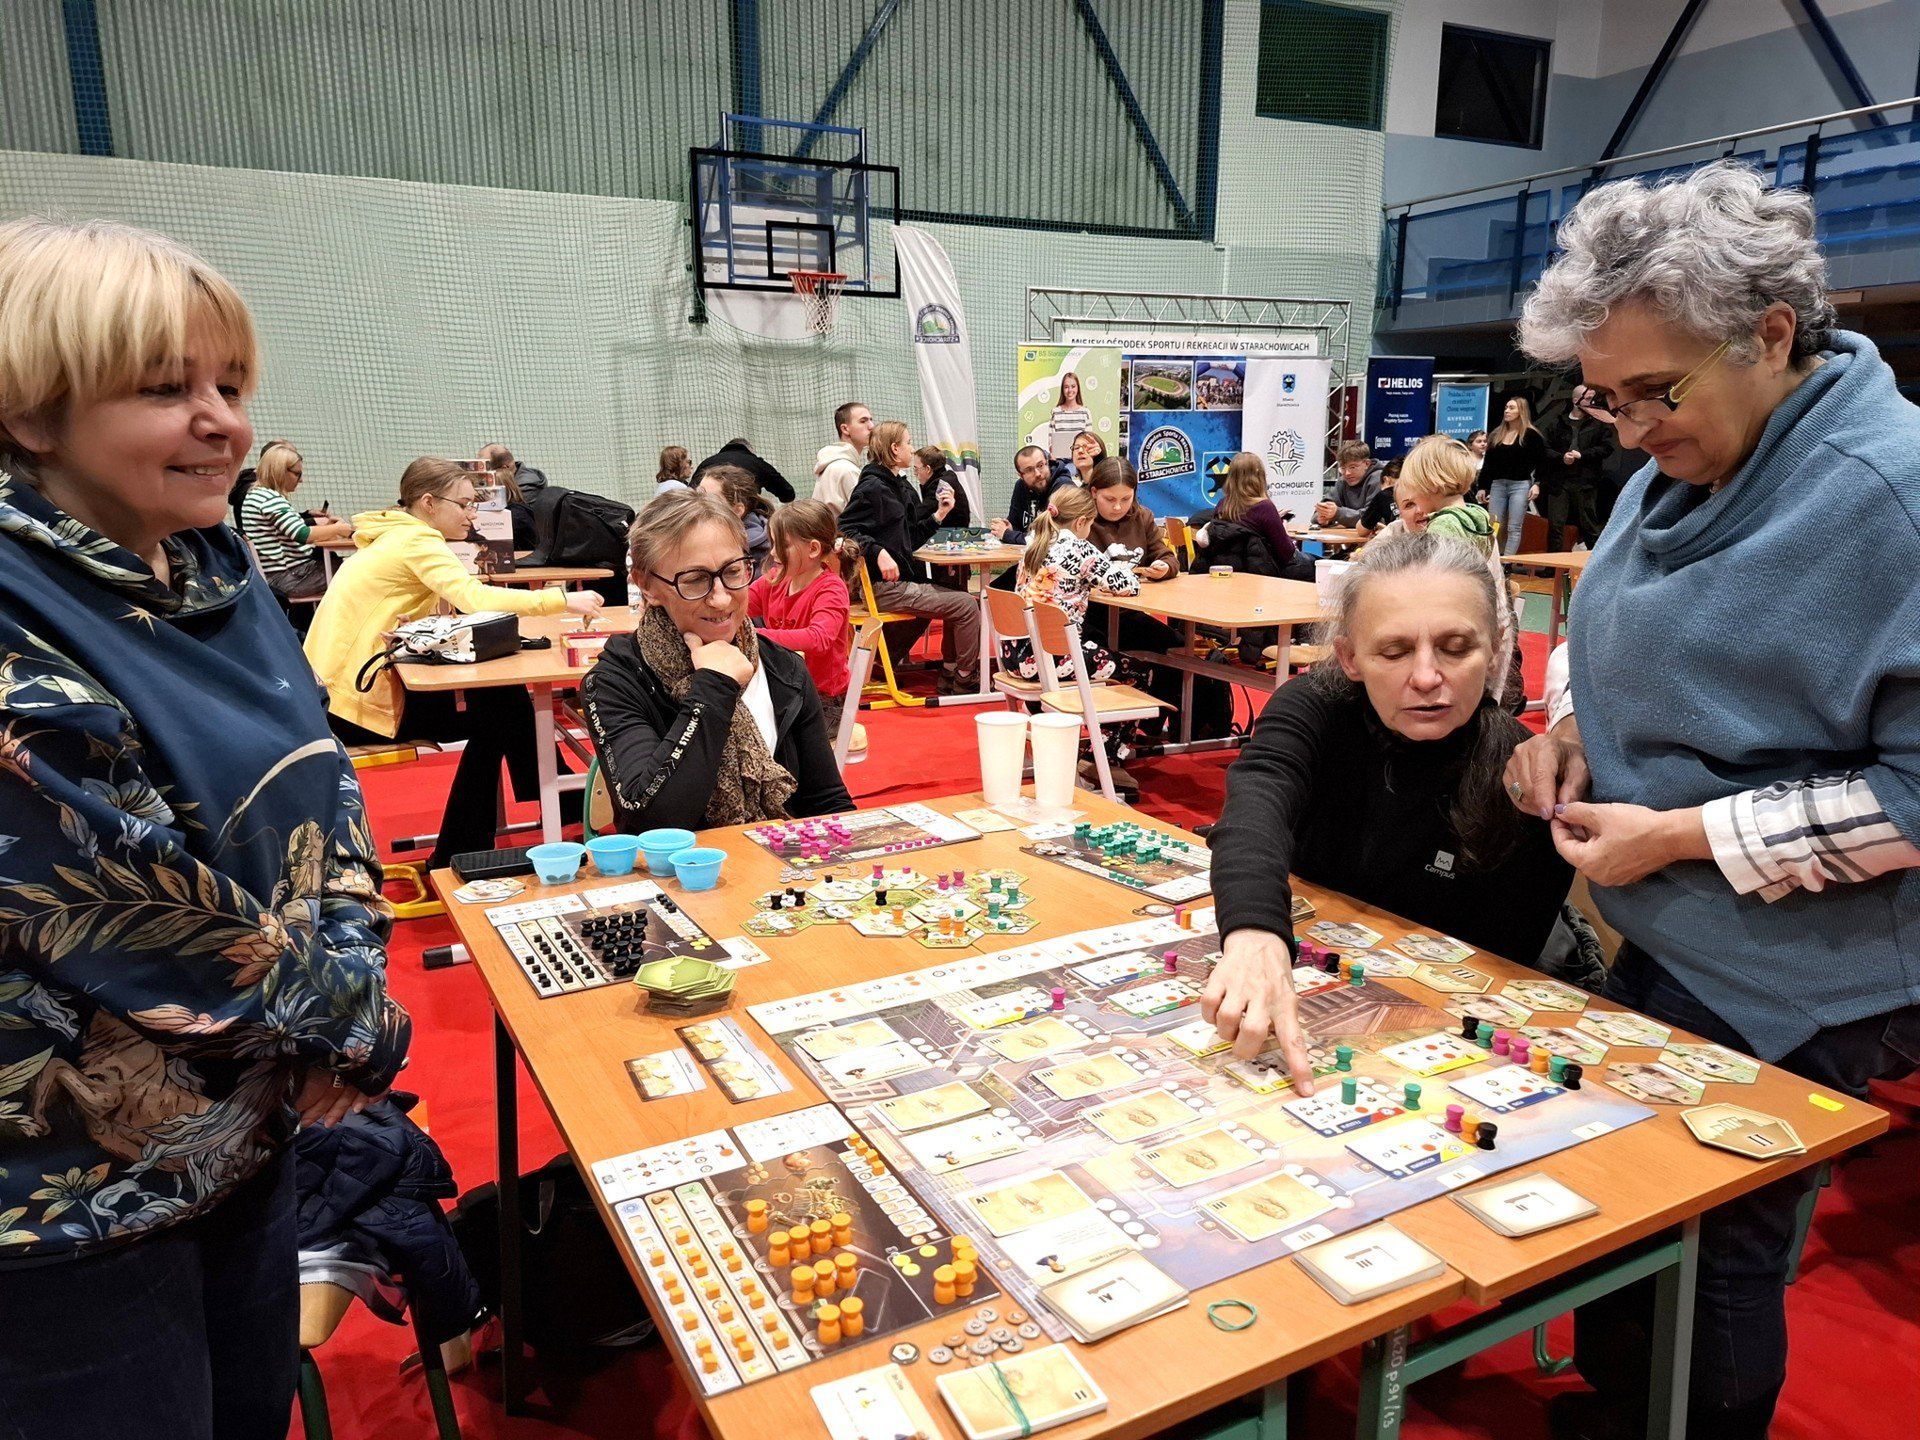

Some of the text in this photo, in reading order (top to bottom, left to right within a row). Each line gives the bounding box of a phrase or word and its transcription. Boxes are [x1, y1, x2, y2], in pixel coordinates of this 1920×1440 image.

[1149, 340, 1181, 350] SPORTU
[1186, 341, 1228, 351] REKREACJI
[1229, 342, 1238, 350] W
[1239, 342, 1310, 351] STARACHOWICACH
[1391, 378, 1423, 389] HELIOS
[1145, 464, 1189, 479] STARACHOWICE
[1107, 571, 1127, 585] GIRL
[591, 713, 606, 737] STRON
[671, 746, 684, 760] BE
[1424, 863, 1456, 880] Campus
[1452, 969, 1476, 979] III
[1747, 1133, 1774, 1147] II
[1212, 1201, 1227, 1210] III
[1515, 1204, 1529, 1212] II
[1356, 1259, 1373, 1268] III
[1075, 1389, 1087, 1401] II
